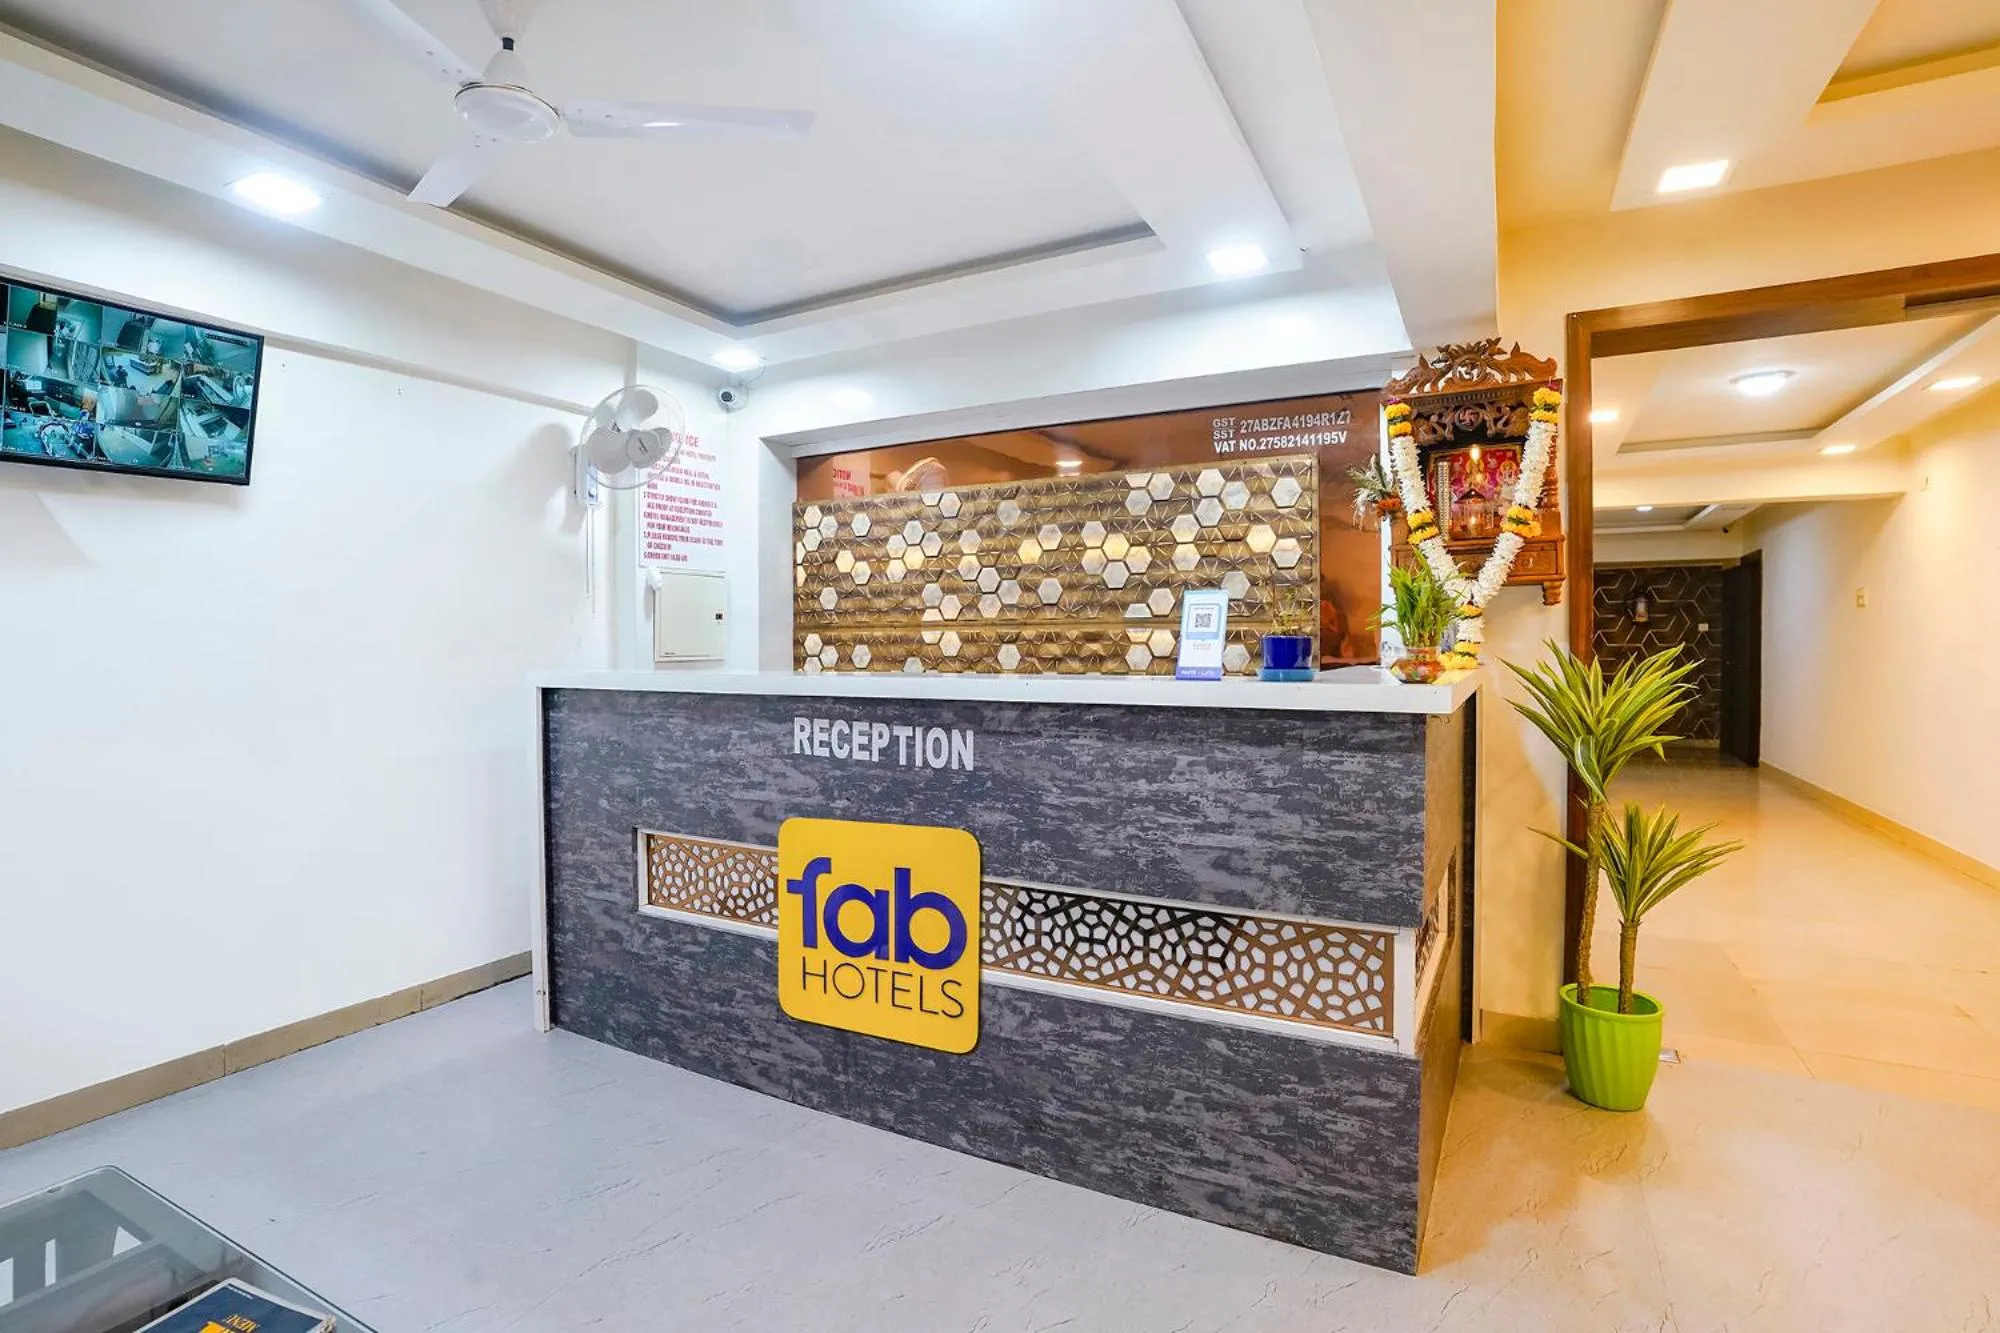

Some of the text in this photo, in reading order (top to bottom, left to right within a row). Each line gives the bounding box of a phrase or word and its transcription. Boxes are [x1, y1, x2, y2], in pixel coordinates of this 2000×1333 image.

[1212, 417, 1236, 428] GST
[1213, 429, 1236, 440] SST
[1214, 440, 1236, 454] VAT
[793, 716, 975, 772] RECEPTION
[786, 856, 968, 971] fab
[802, 956, 965, 1019] HOTELS
